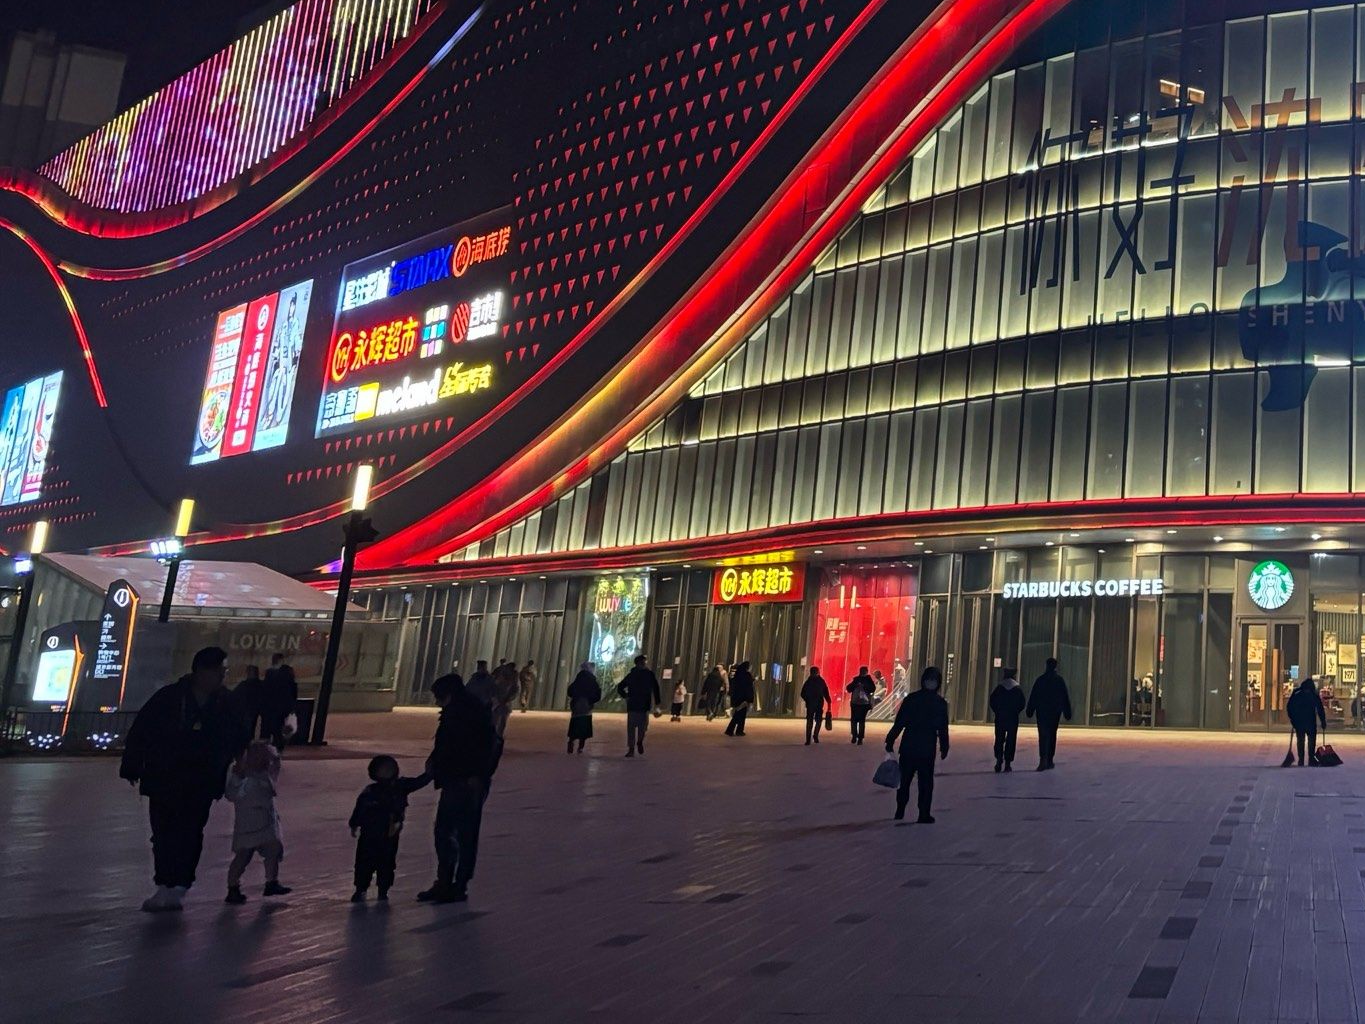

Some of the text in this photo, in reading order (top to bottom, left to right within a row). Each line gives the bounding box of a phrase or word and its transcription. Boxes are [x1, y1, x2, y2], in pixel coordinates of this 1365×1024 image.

[350, 317, 418, 370] 永辉超市
[738, 566, 792, 596] 永辉超市
[1003, 578, 1163, 599] STARBUCKS COFFEE
[229, 634, 299, 650] LOVE IN
